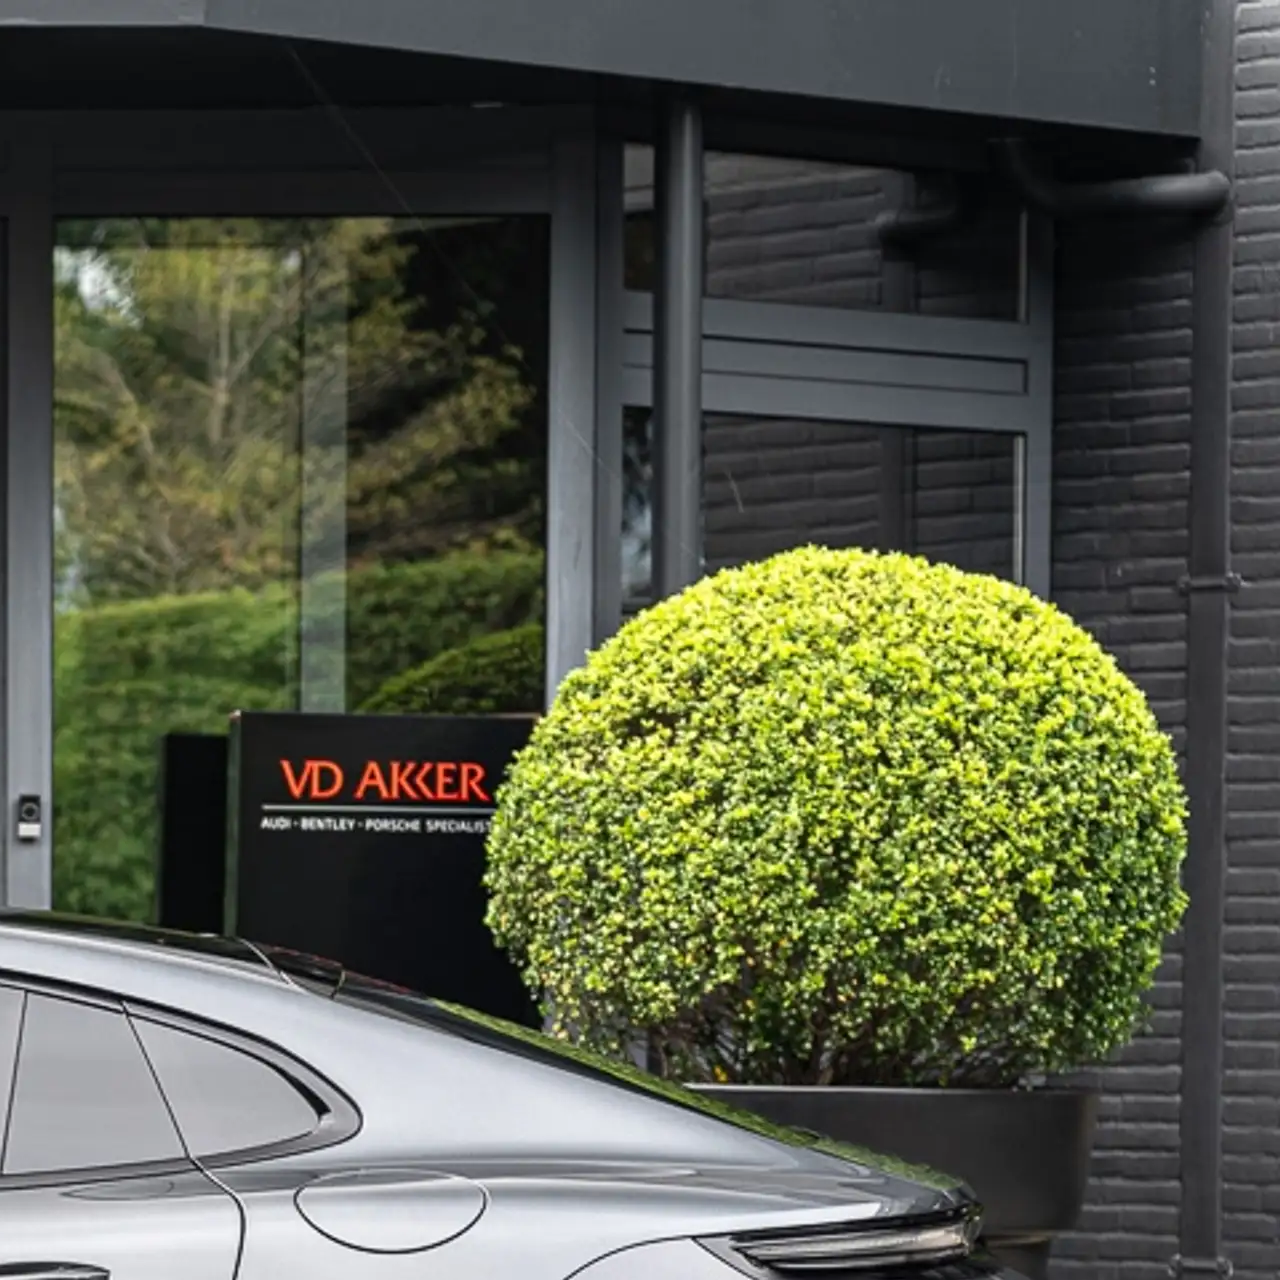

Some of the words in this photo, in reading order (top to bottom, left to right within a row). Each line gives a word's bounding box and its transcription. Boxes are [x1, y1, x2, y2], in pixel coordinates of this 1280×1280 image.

[280, 759, 344, 800] VD
[354, 761, 490, 800] AKKER
[261, 816, 291, 830] AUDI
[300, 817, 355, 832] BENTLEY
[364, 818, 420, 832] PORSCHE
